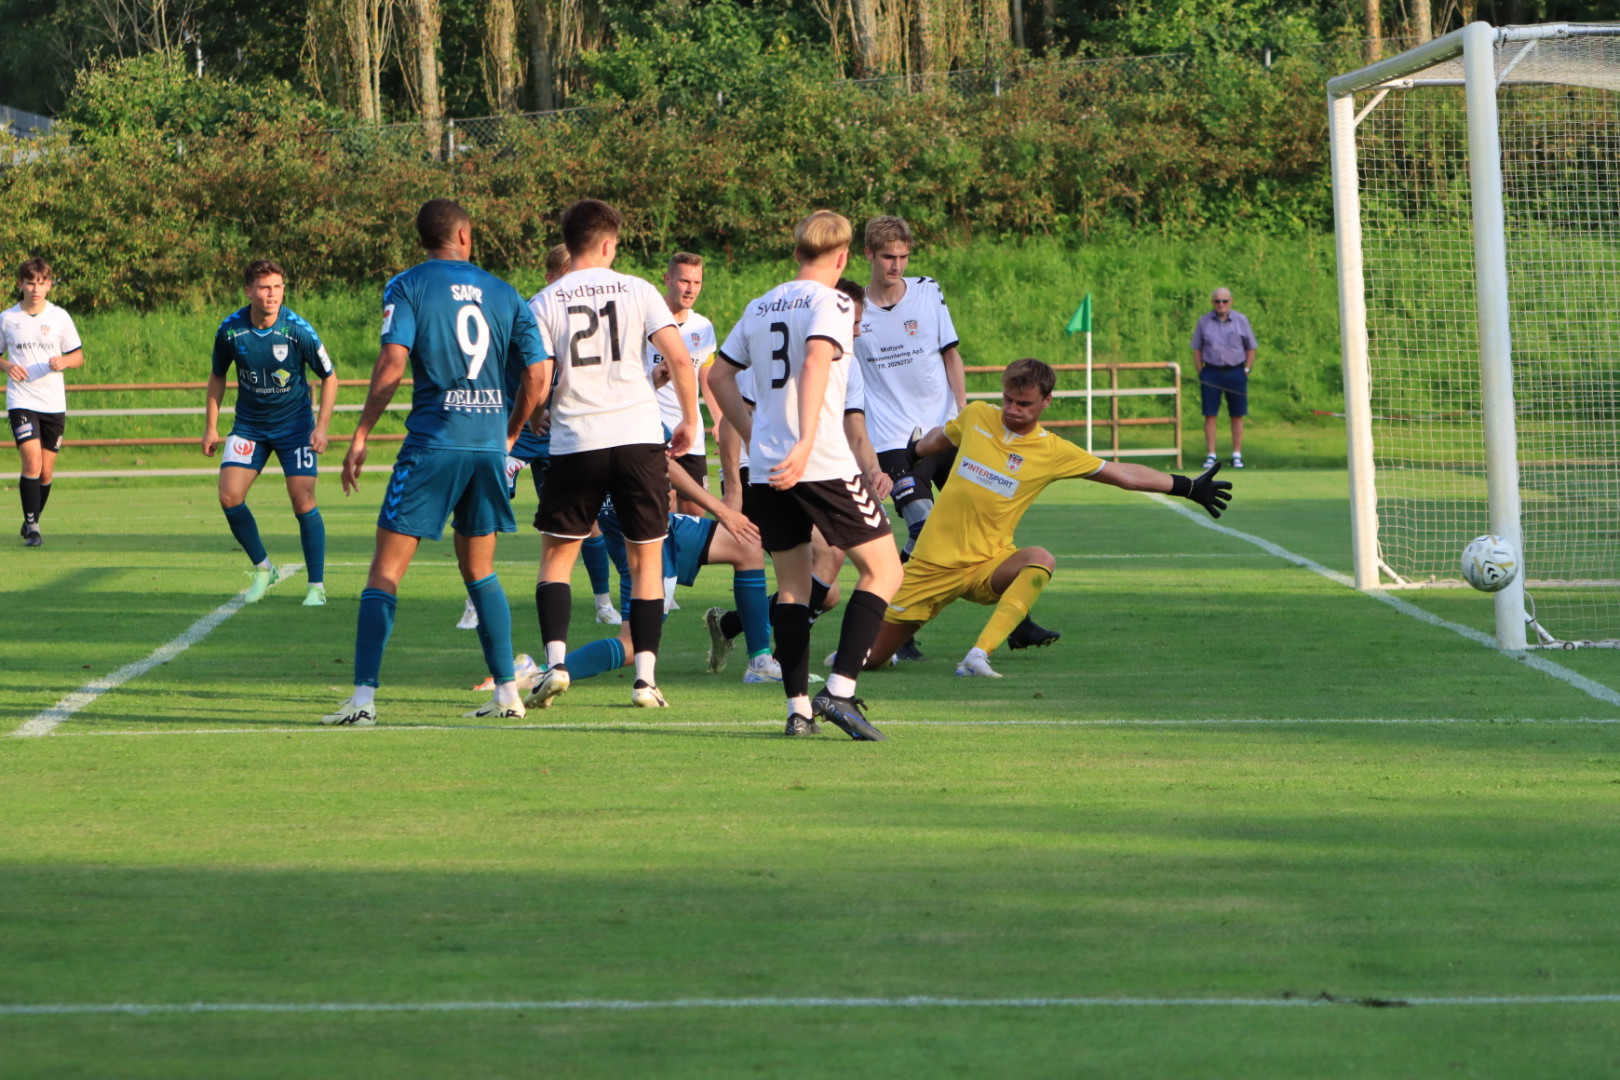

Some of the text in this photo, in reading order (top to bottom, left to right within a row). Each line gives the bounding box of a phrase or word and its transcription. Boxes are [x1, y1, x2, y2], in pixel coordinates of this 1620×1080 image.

[451, 284, 483, 304] SARR
[555, 281, 629, 303] Sydbank
[456, 304, 490, 380] 9
[567, 300, 621, 368] 21
[770, 321, 791, 389] 3
[294, 446, 314, 469] 15
[967, 463, 1014, 489] INTERSPORT
